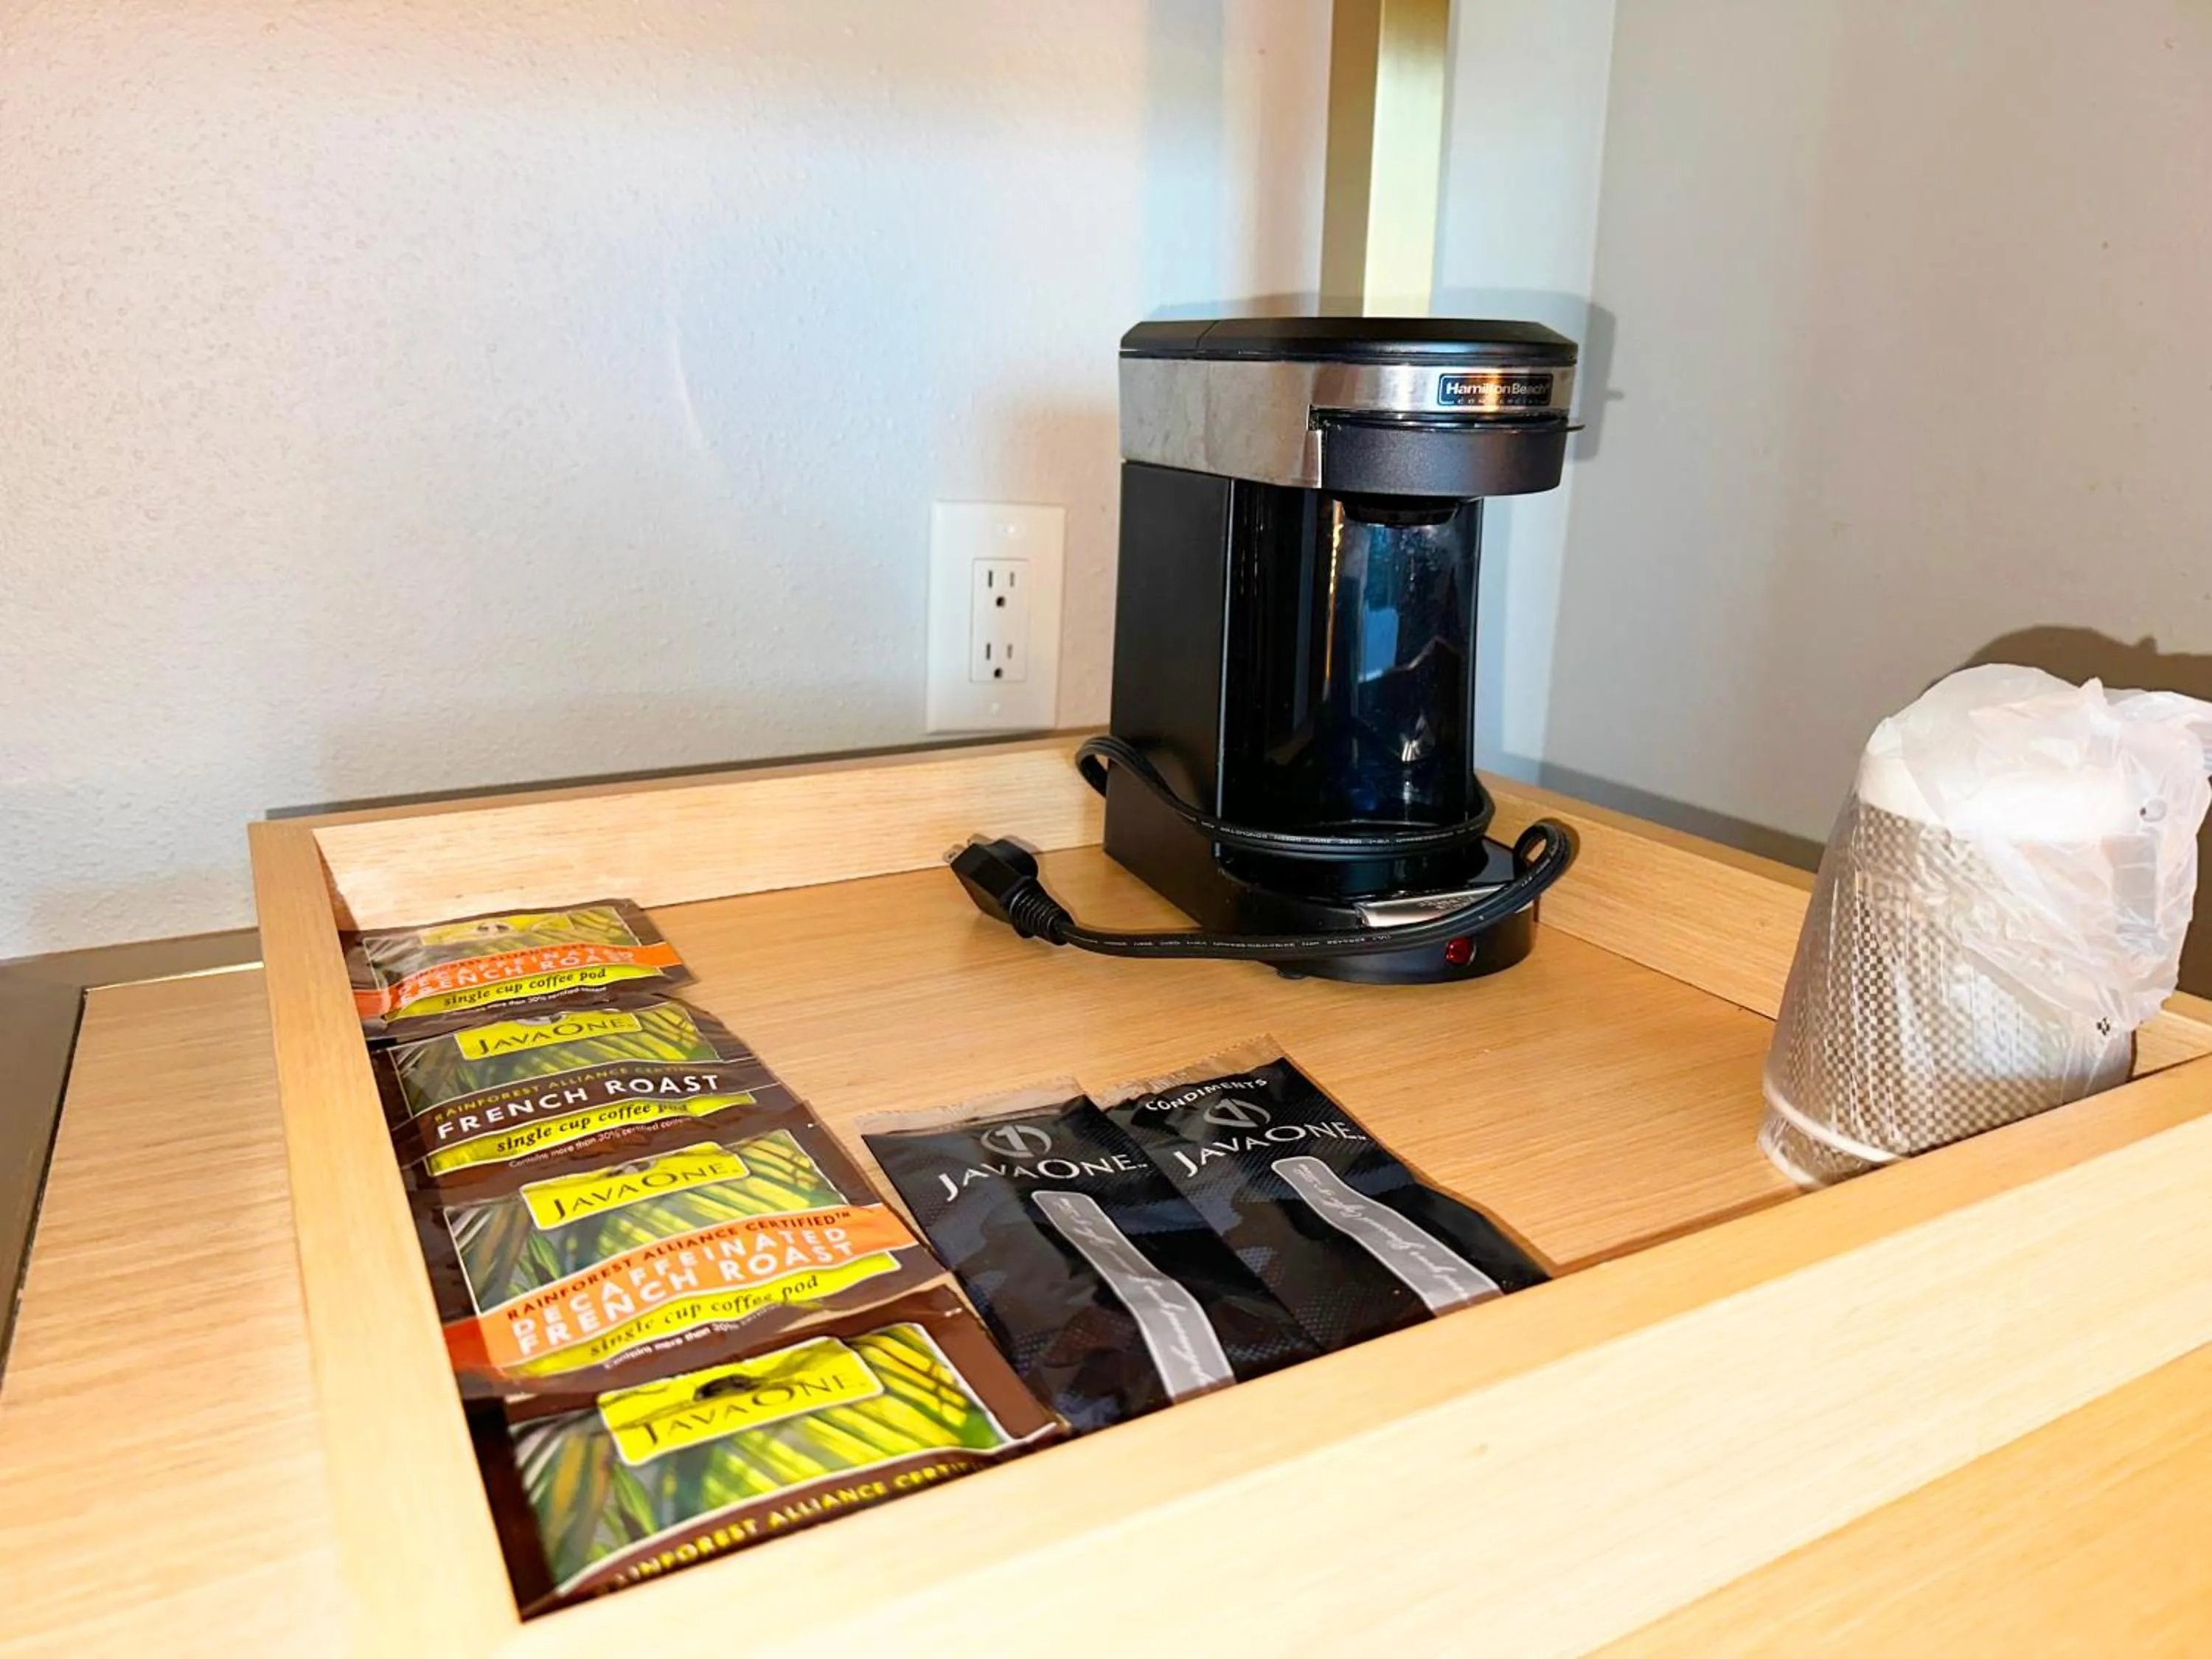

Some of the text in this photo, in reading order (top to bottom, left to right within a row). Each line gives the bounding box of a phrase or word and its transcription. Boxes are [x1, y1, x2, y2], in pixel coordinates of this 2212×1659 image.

[444, 969, 606, 1006] single cup coffee pod
[434, 1085, 540, 1124] RAINFOREST
[549, 1068, 627, 1089] ALLIANCE
[437, 1074, 718, 1139] FRENCH ROAST
[1145, 1078, 1268, 1111] CONDIMENTS
[497, 1127, 552, 1152] single
[559, 1116, 591, 1131] cup
[598, 1104, 651, 1121] coffee
[507, 1257, 632, 1321] RAINFOREST
[643, 1227, 738, 1261] ALLIANCE
[512, 1227, 846, 1339] DECAFFEINATED
[518, 1240, 853, 1357] FRENCH ROAST
[591, 1275, 818, 1357] single cup coffee pod
[767, 1481, 888, 1528] ALLIANCE
